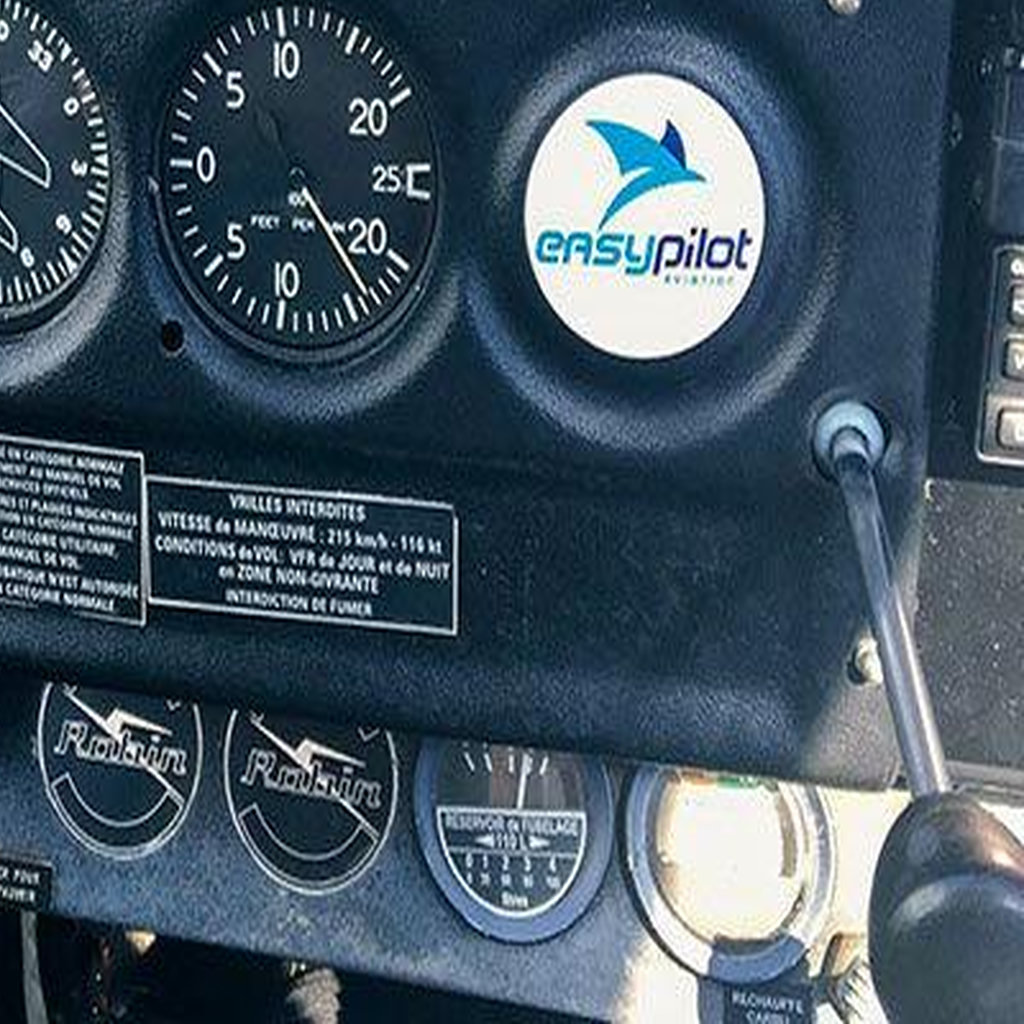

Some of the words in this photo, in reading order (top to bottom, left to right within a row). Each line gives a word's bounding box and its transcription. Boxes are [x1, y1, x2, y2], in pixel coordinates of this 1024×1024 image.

[27, 40, 54, 71] 33
[273, 40, 301, 80] 10
[226, 71, 246, 109] 5
[348, 97, 389, 137] 20
[196, 145, 217, 184] 0
[372, 164, 402, 193] 25
[226, 223, 246, 261] 5
[347, 217, 388, 256] 20
[273, 261, 301, 299] 10
[157, 509, 211, 532] VITESSE
[54, 719, 188, 776] Robin
[241, 747, 382, 810] Robin
